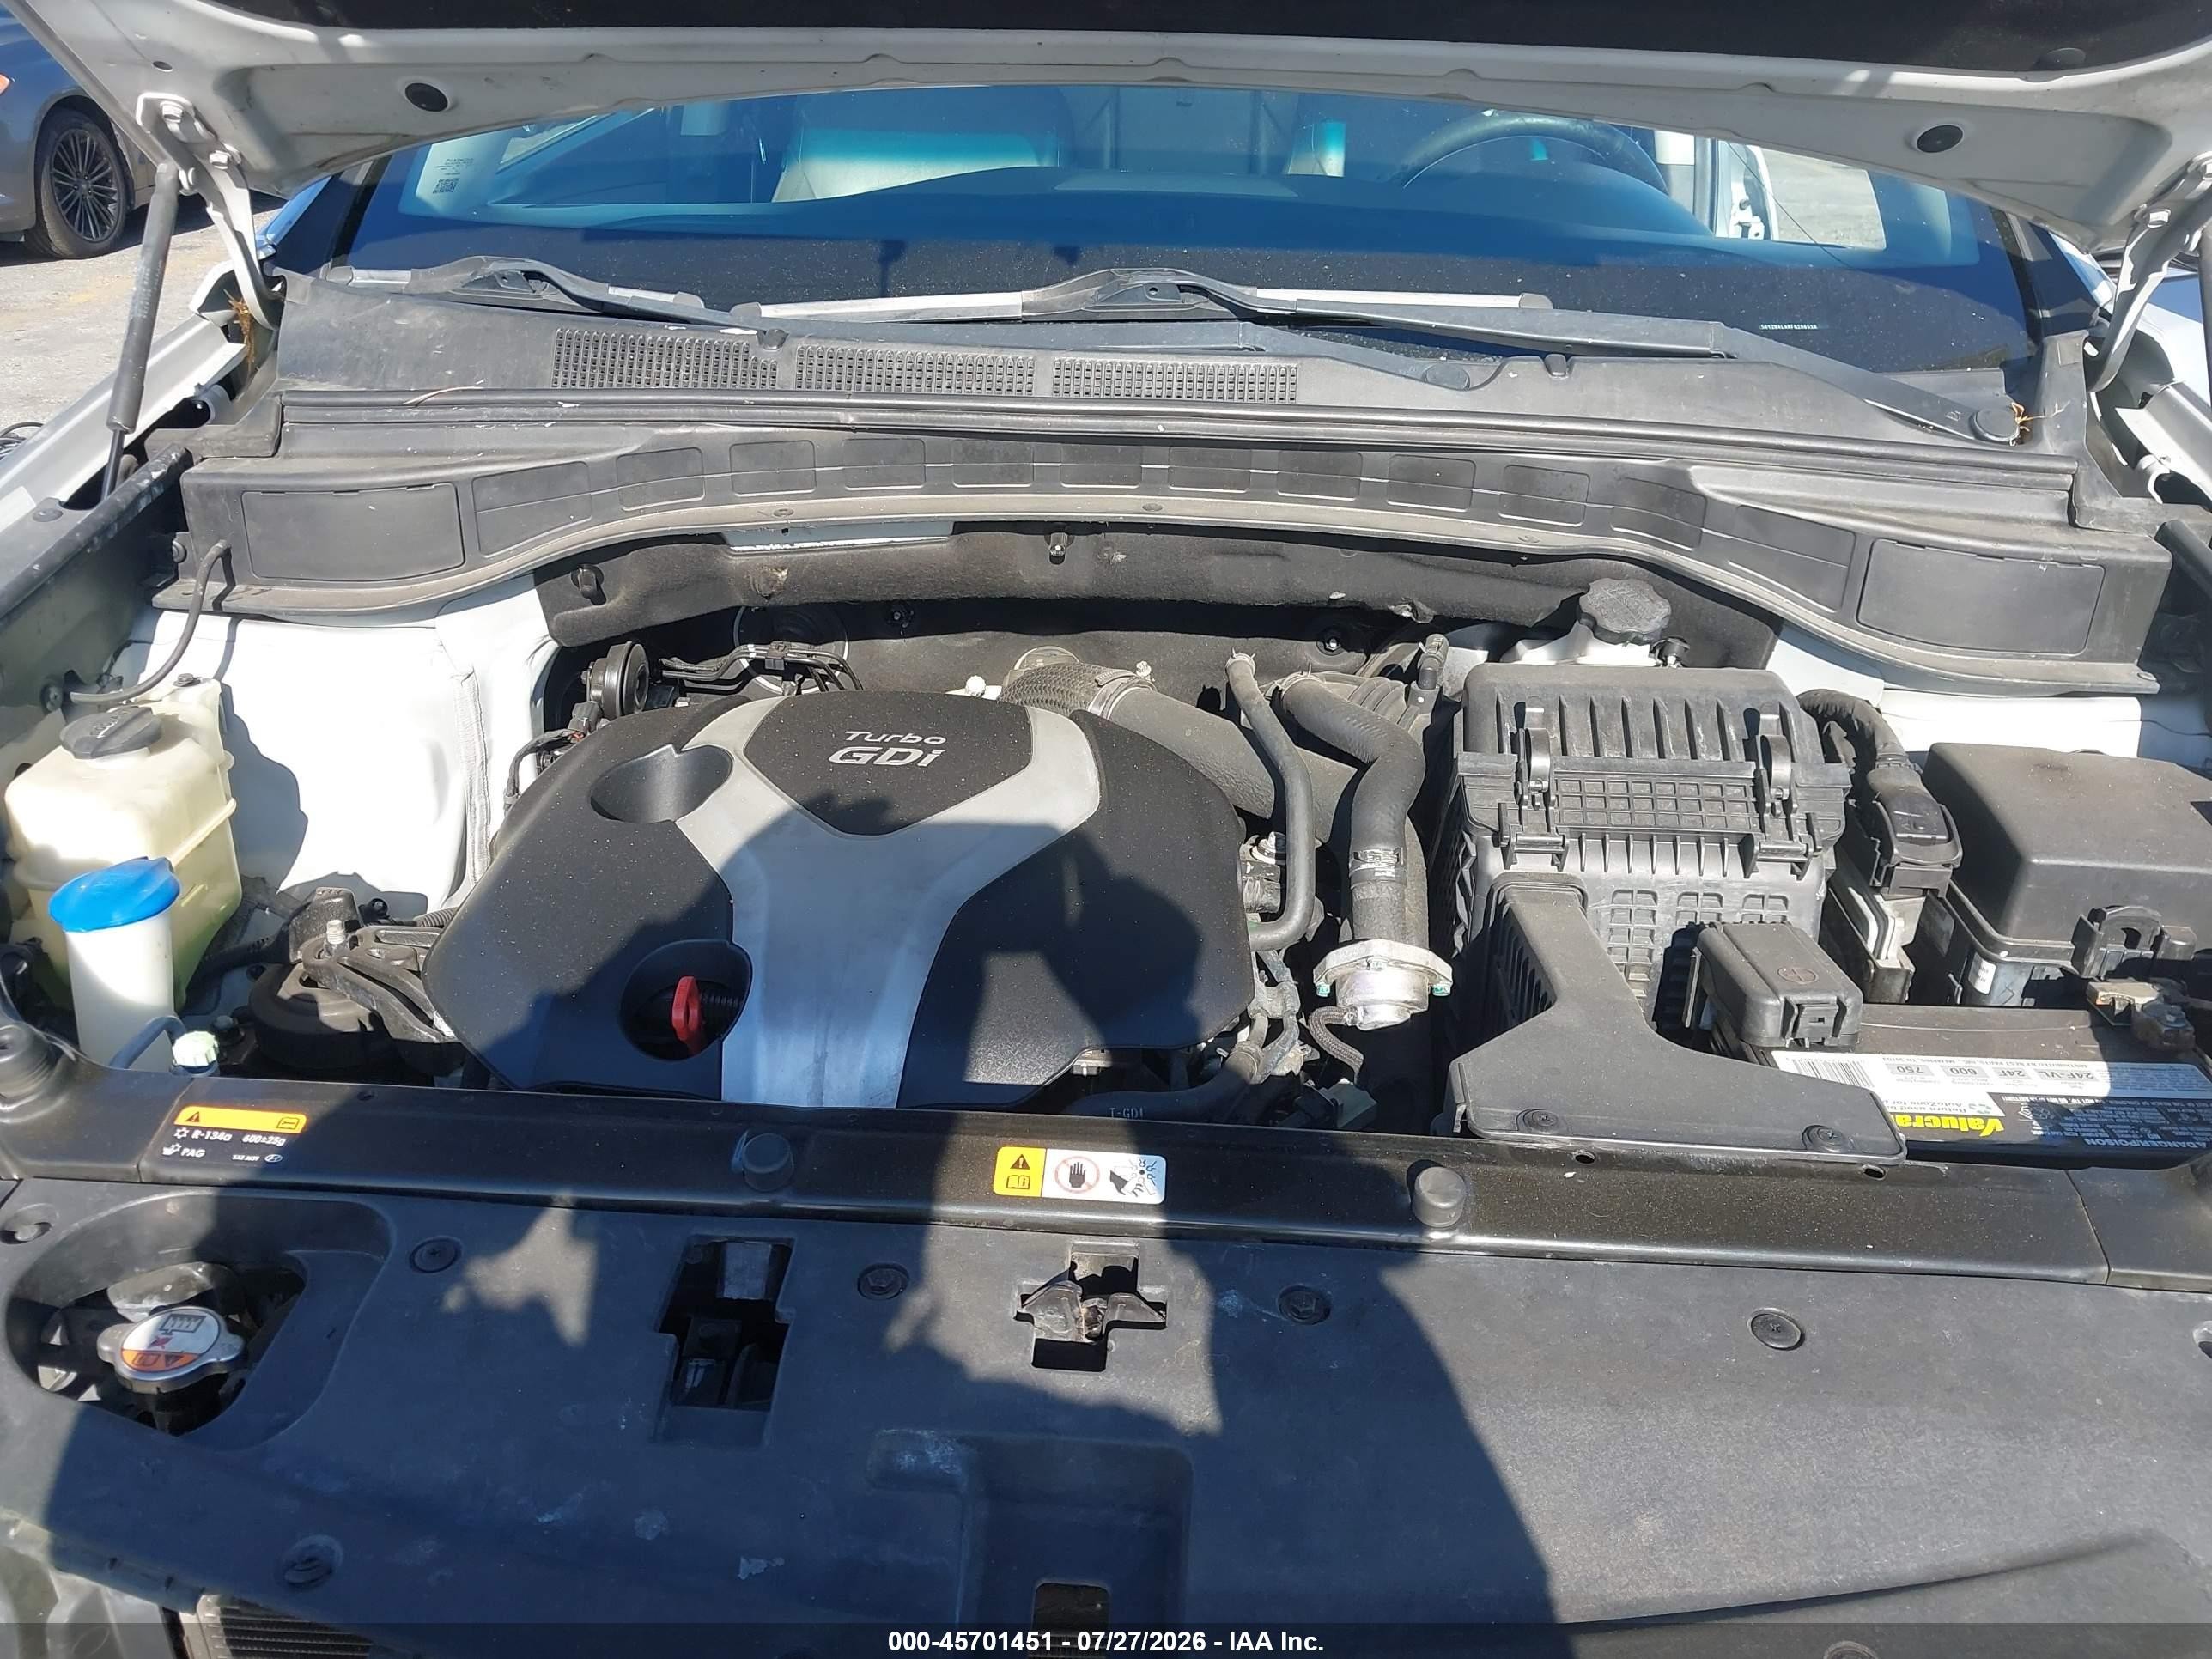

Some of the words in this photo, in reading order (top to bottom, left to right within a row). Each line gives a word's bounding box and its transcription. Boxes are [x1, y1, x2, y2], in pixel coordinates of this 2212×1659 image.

[844, 730, 947, 744] Turbo
[828, 746, 946, 767] GDi
[2037, 1071, 2094, 1079] 24F-VL
[1890, 1115, 2004, 1137] Valucra
[191, 1129, 233, 1142] R-134a
[242, 1134, 287, 1147] 600±25g
[2083, 1139, 2199, 1148] DANGER/POISON
[181, 1147, 206, 1158] PAG
